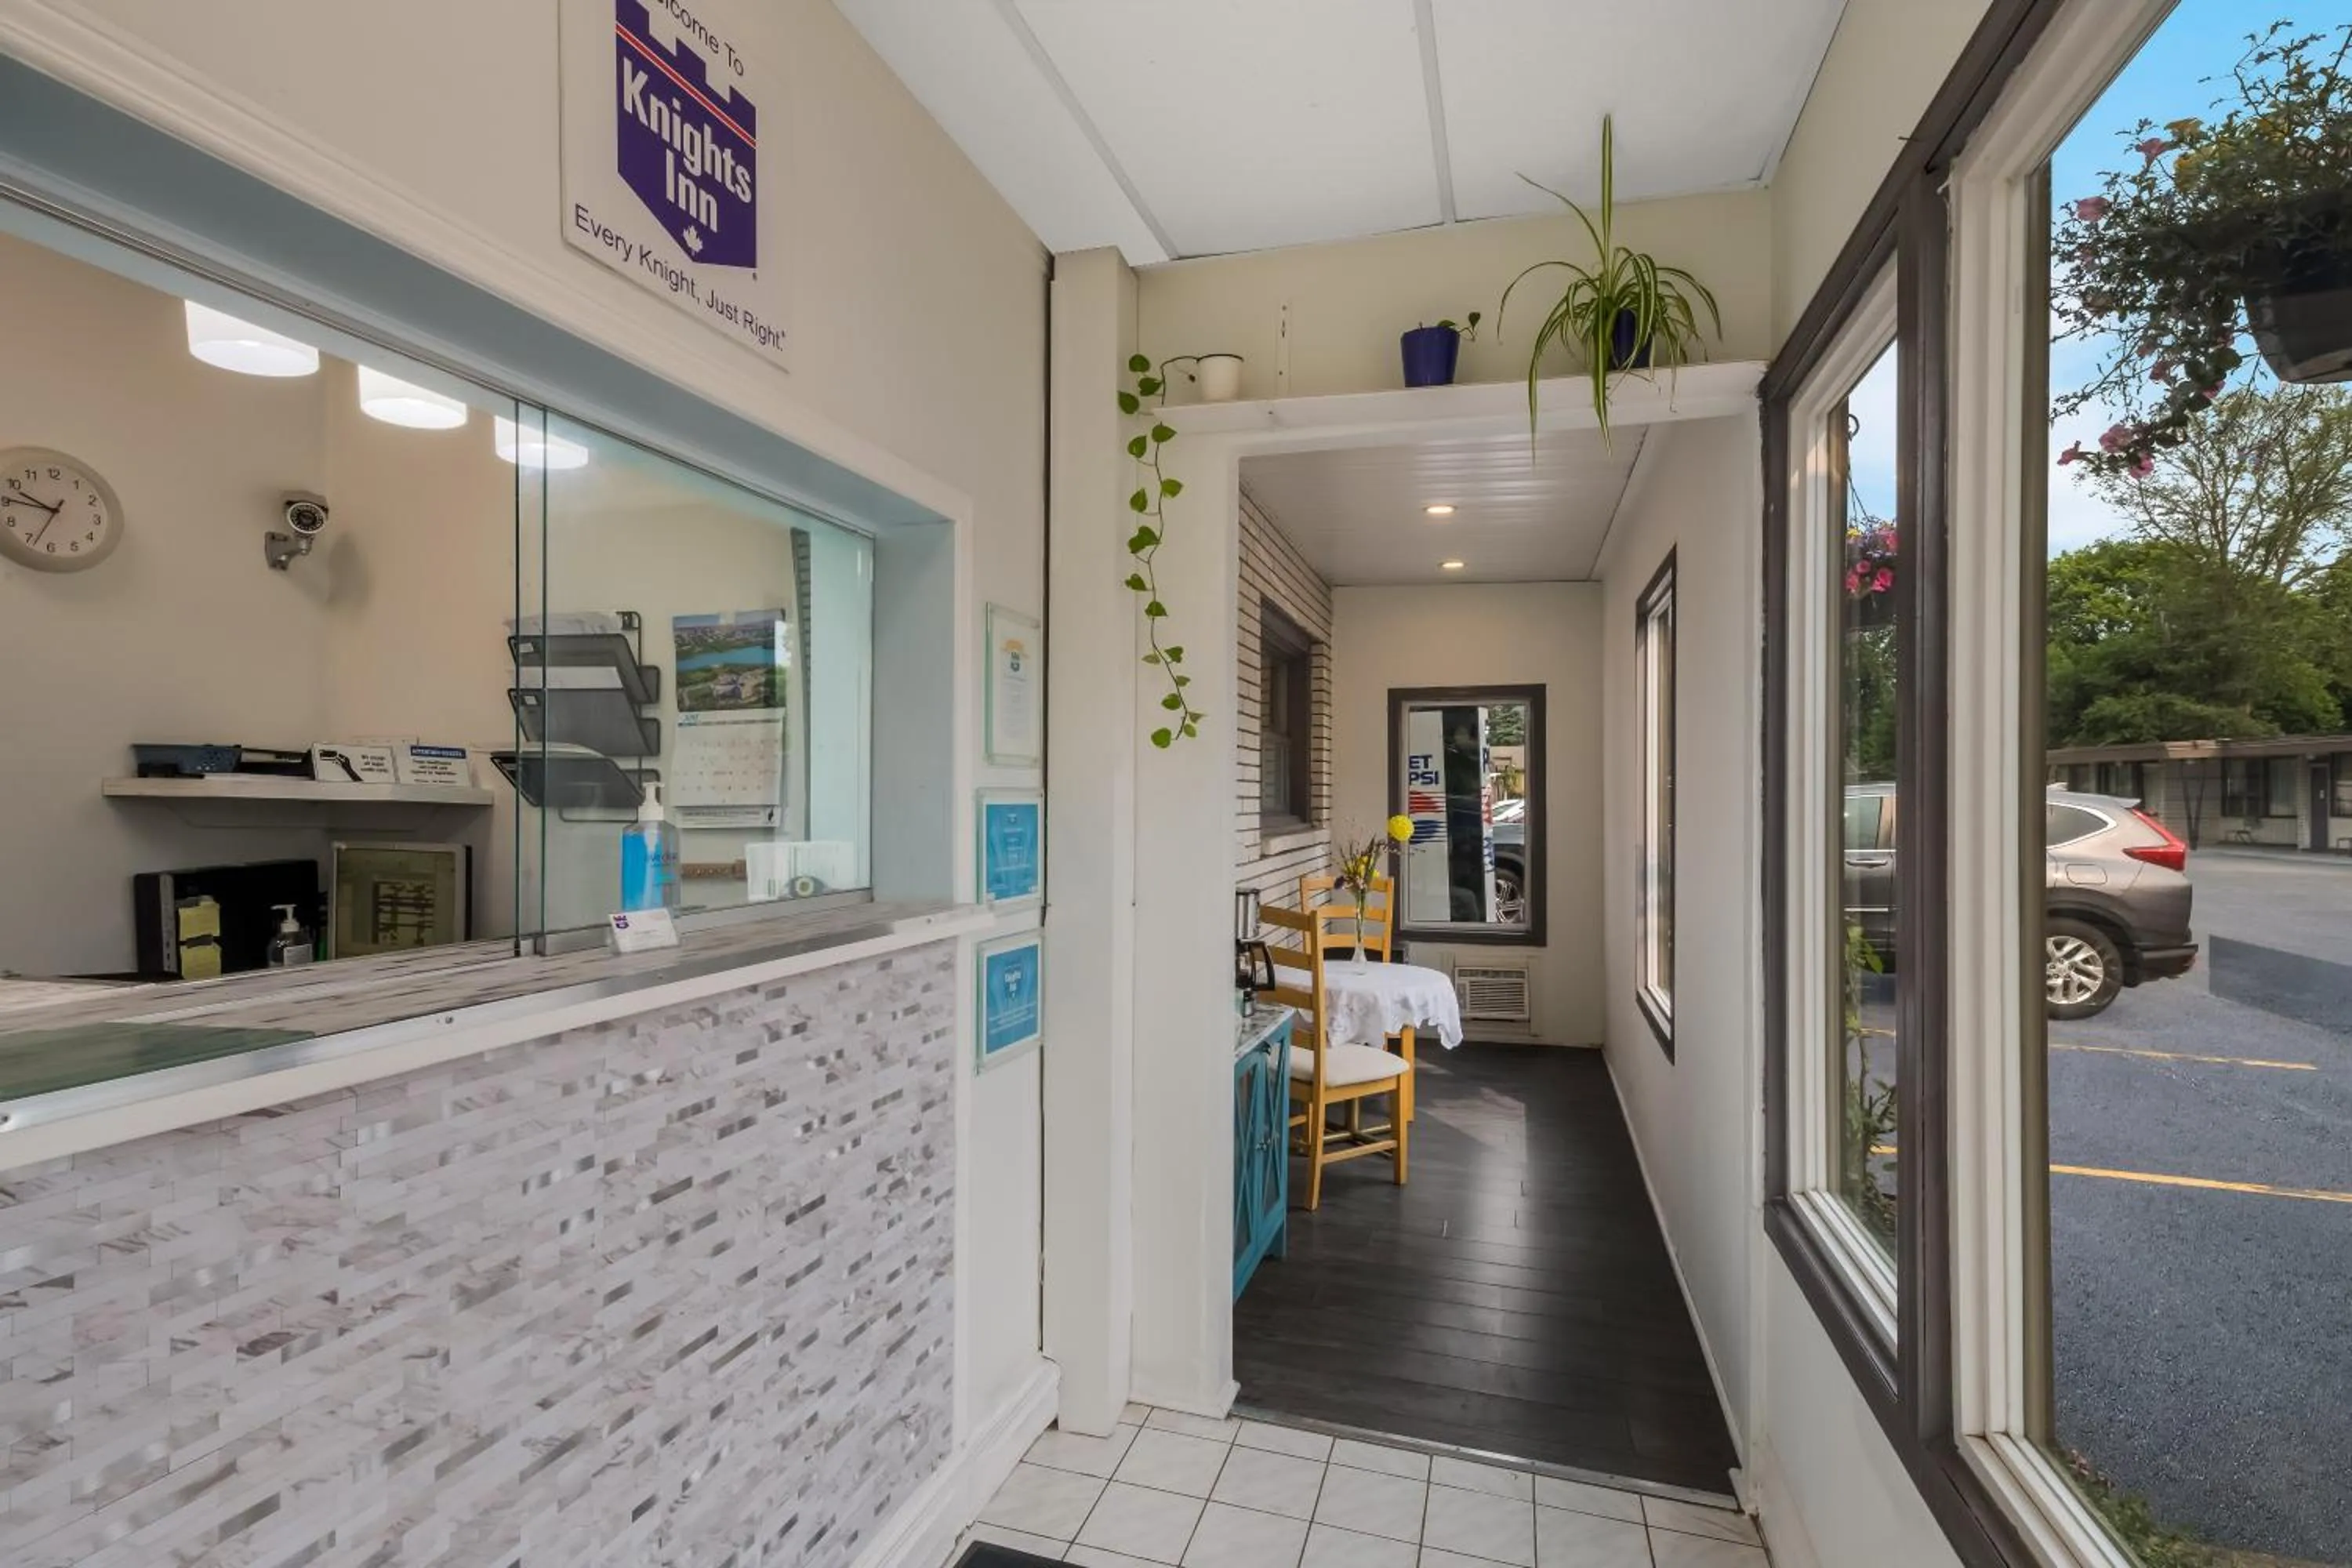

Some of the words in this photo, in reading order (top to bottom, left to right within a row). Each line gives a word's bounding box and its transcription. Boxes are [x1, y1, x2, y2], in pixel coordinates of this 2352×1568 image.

[658, 0, 719, 54] come
[724, 42, 744, 76] To
[623, 56, 752, 204] Knights
[666, 148, 717, 233] Inn
[575, 203, 633, 262] Every
[639, 244, 700, 304] Knight,
[706, 289, 739, 325] Just
[25, 469, 37, 481] 11
[49, 468, 61, 480] 12
[7, 478, 21, 490] 10
[88, 494, 97, 506] 2
[6, 517, 16, 527] 8
[93, 514, 101, 525] 3
[25, 532, 33, 543] 7
[85, 531, 94, 543] 4
[47, 542, 56, 553] 6
